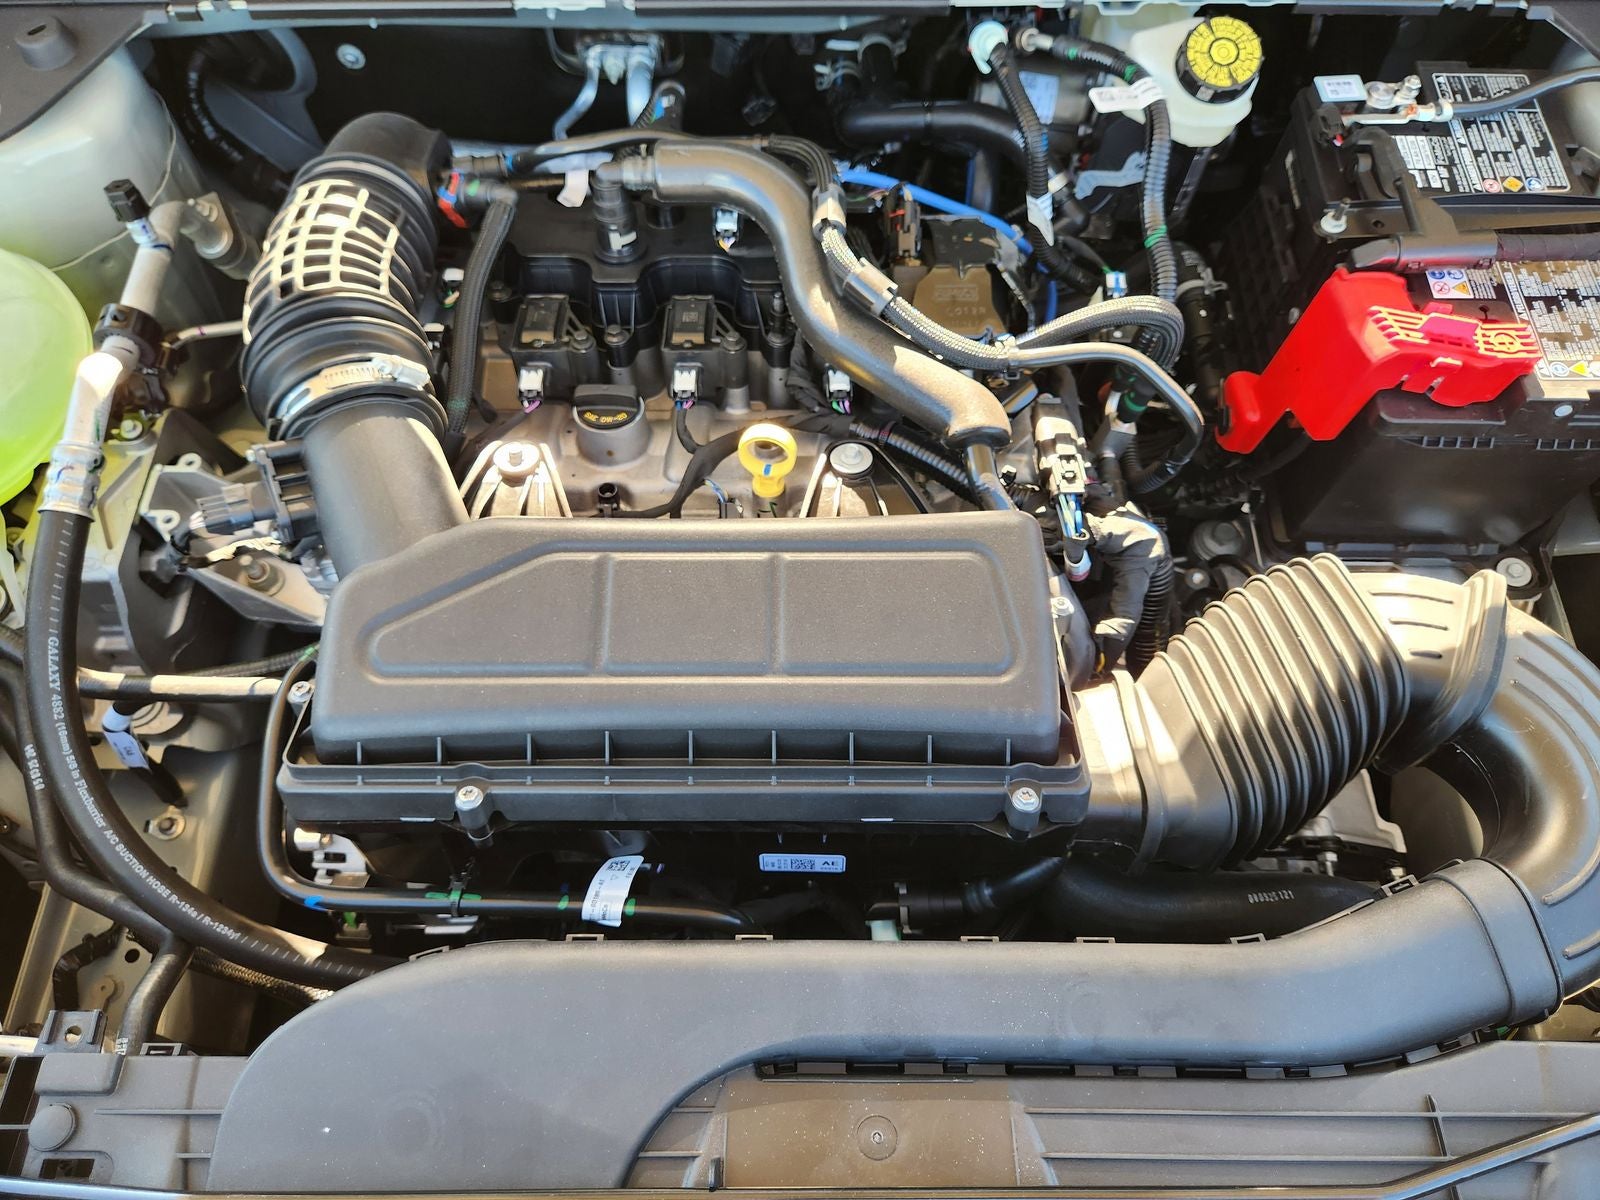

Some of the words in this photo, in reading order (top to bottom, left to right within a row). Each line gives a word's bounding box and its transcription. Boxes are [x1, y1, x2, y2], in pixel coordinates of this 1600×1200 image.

[48, 636, 60, 691] GALAXY
[51, 693, 65, 720] 4882
[55, 722, 73, 755] (16mm)
[74, 778, 106, 828] Flexbarrier
[103, 829, 119, 845] A/C
[115, 843, 150, 879] SUCTION
[145, 875, 171, 898] HOSE
[168, 893, 198, 919] R-134a
